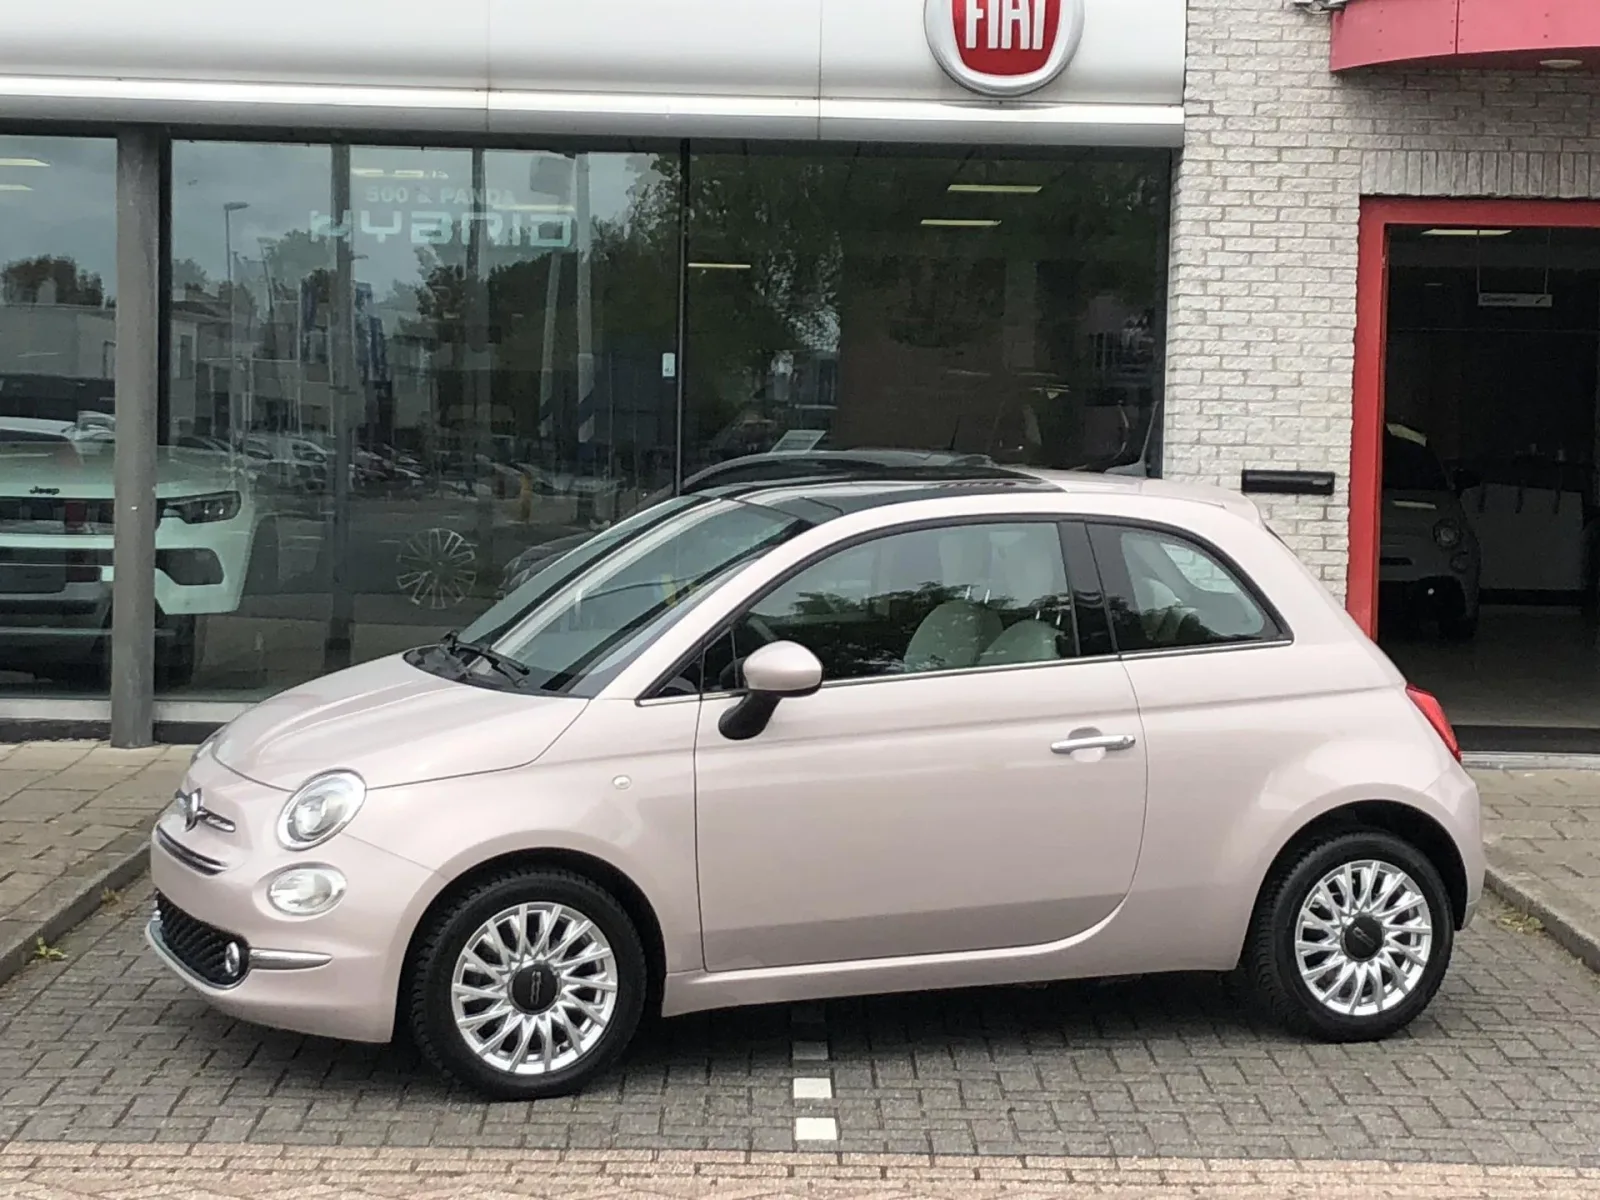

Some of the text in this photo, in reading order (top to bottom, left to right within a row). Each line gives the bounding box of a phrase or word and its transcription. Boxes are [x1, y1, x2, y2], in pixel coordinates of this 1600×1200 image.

[364, 186, 409, 203] 500
[440, 188, 517, 206] PANDA
[309, 209, 572, 248] HYBRID
[29, 485, 60, 496] Jeep
